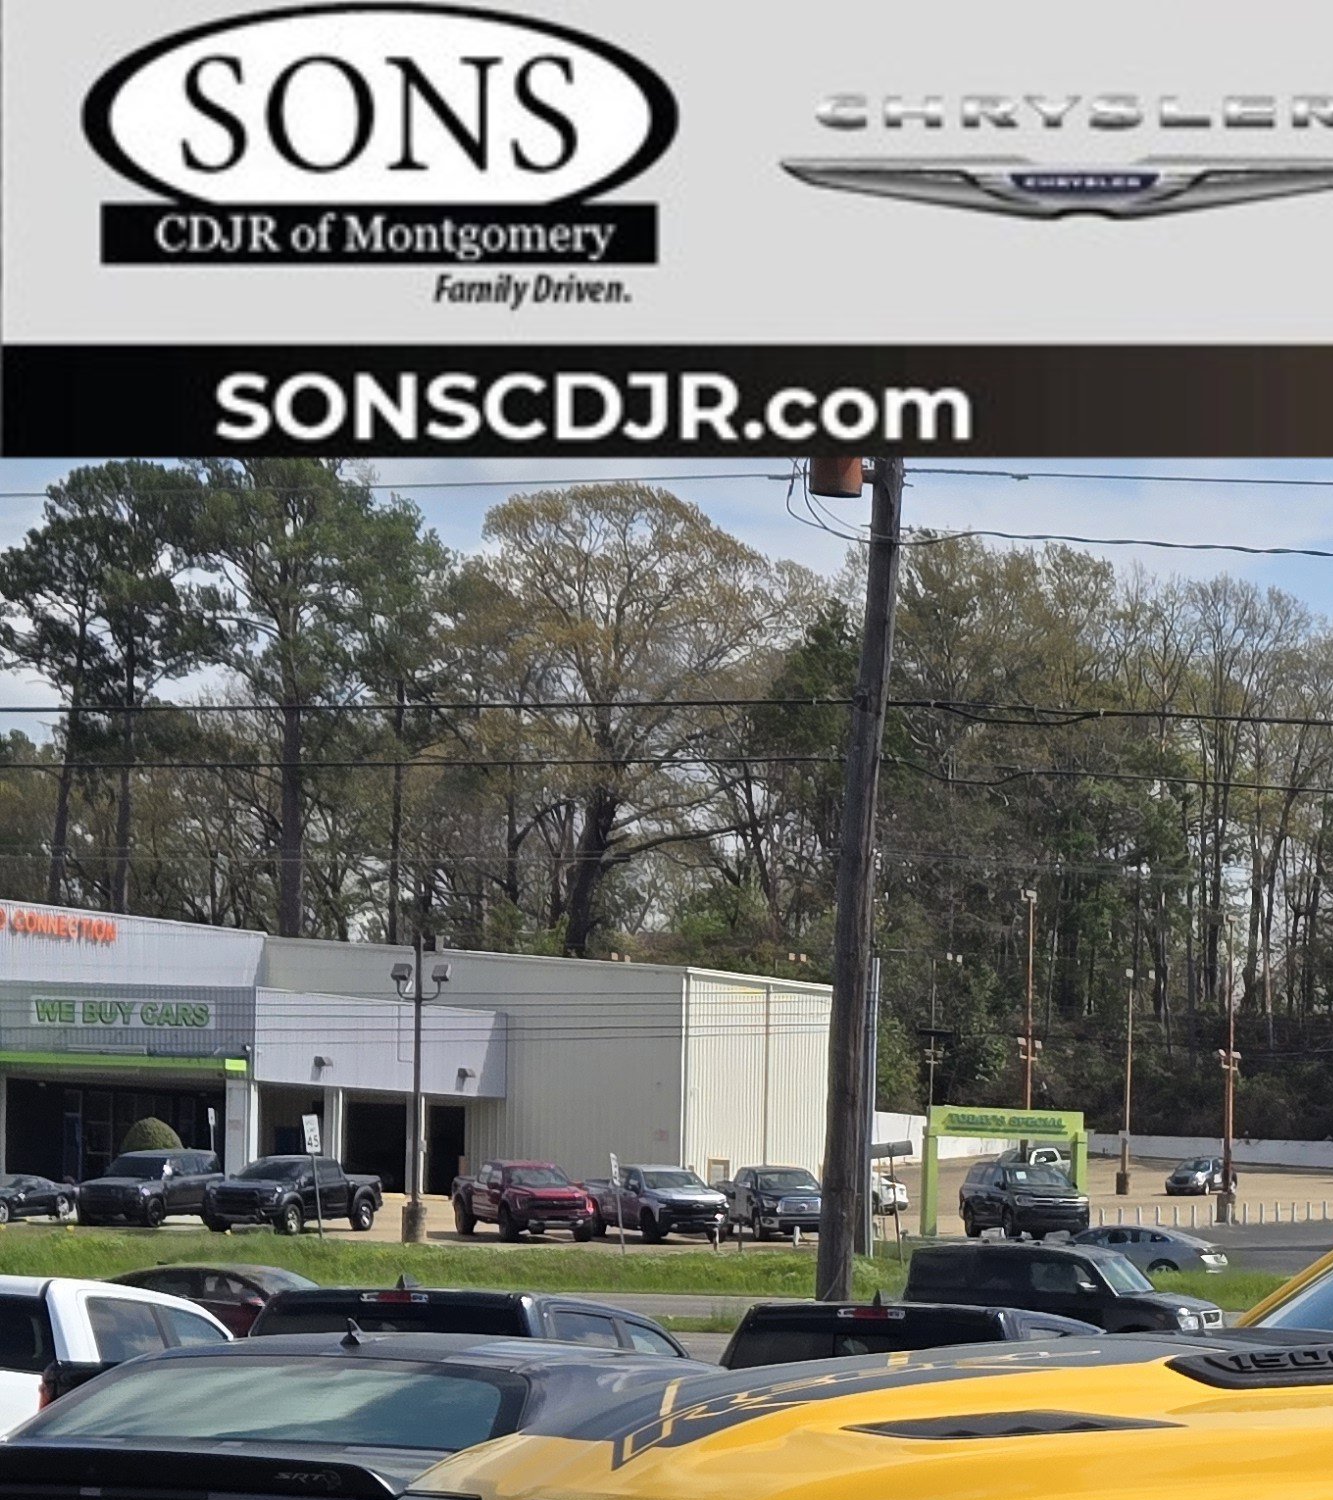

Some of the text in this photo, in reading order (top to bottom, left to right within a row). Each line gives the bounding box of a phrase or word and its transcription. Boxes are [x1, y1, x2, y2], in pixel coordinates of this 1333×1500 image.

[13, 909, 117, 943] CONNECTION
[35, 999, 210, 1027] WE BUY CARS
